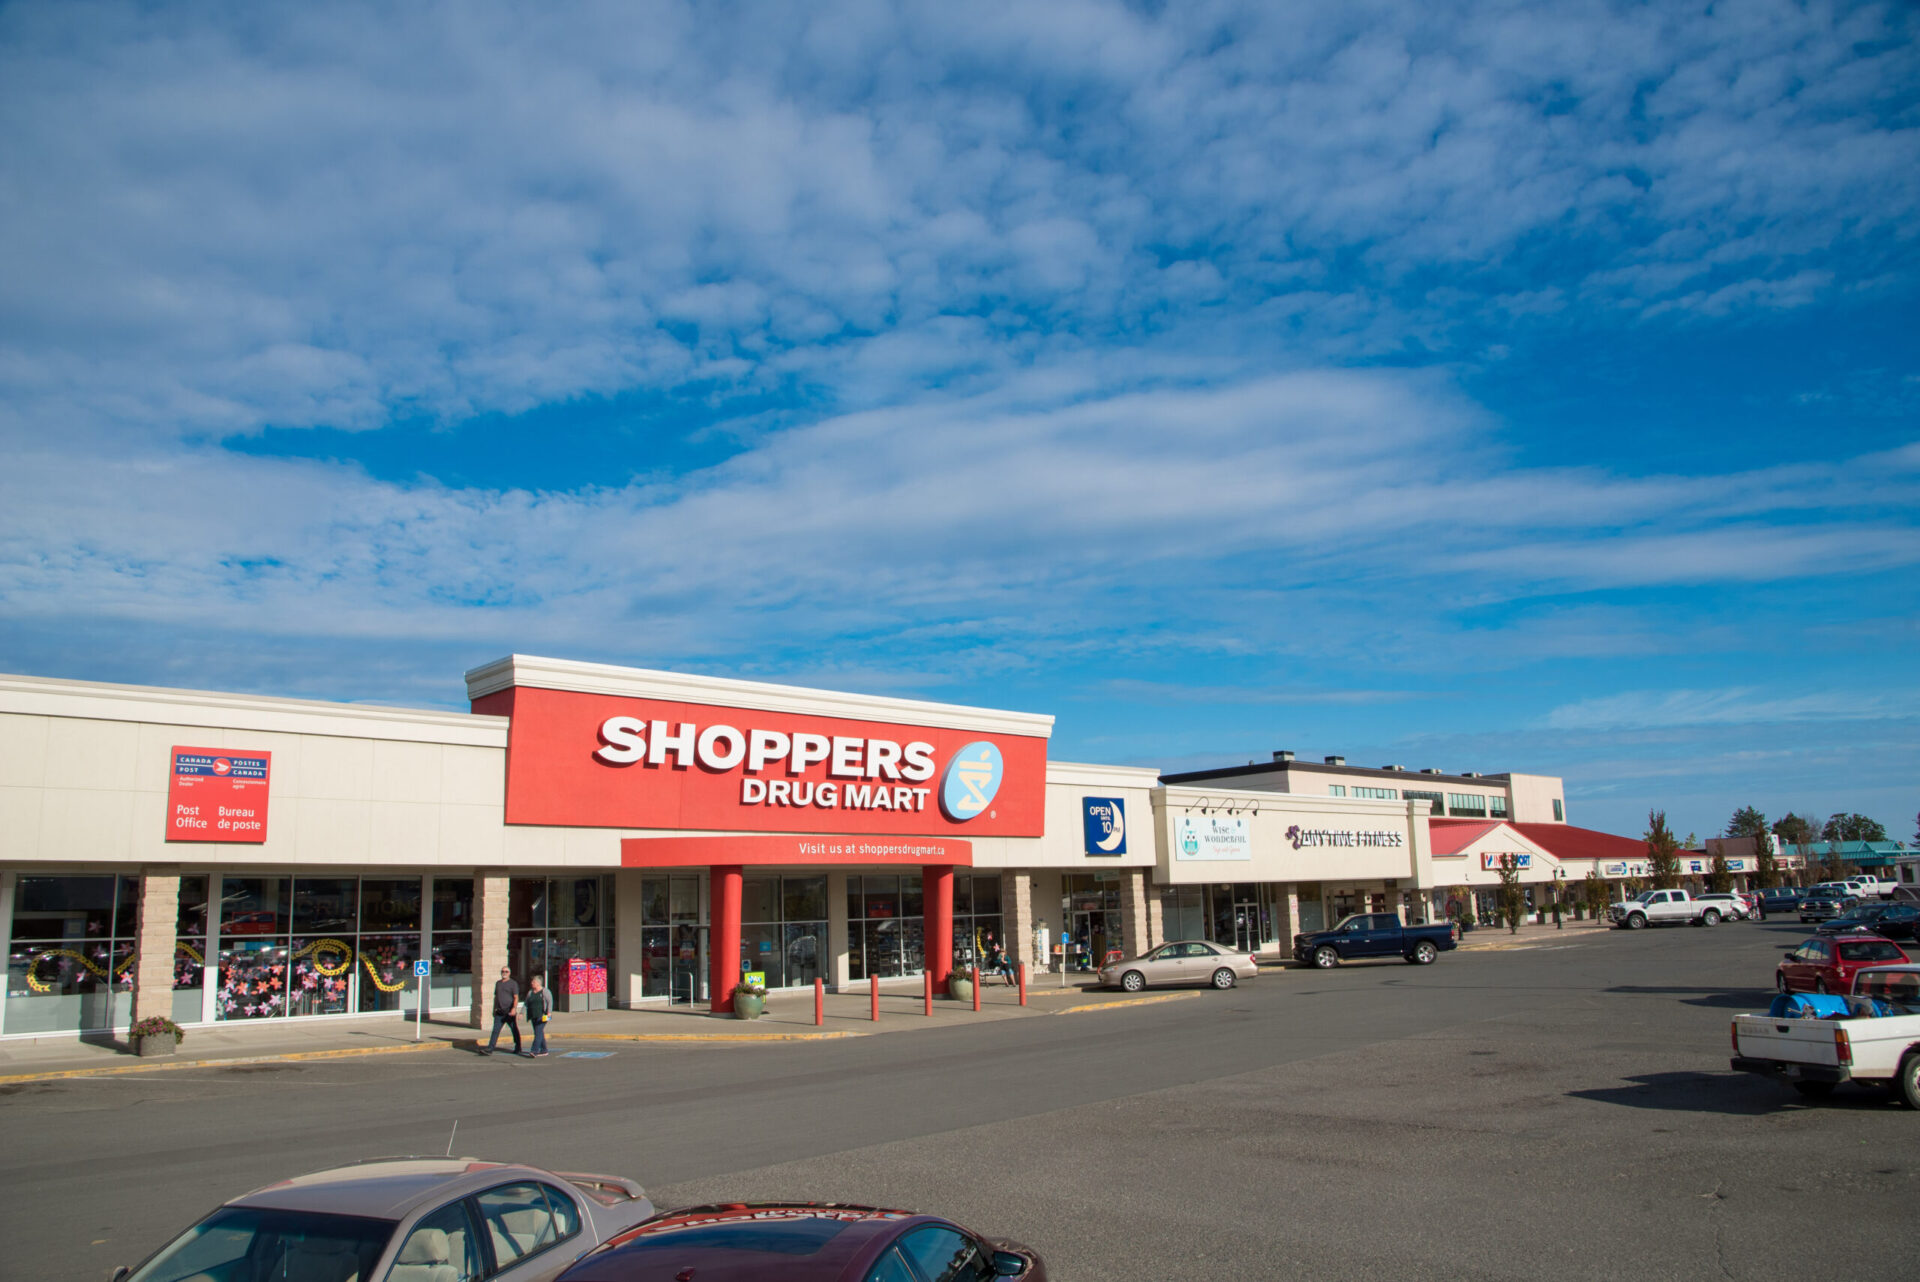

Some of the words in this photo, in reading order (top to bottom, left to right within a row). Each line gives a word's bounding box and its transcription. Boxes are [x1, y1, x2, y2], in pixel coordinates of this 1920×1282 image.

[597, 716, 936, 781] SHOPPERS
[743, 778, 838, 807] DRUG
[845, 784, 931, 811] MART
[177, 804, 200, 816] Post
[218, 806, 254, 817] Bureau
[1089, 806, 1112, 816] OPEN
[176, 817, 208, 828] Office
[218, 819, 231, 829] de
[232, 820, 261, 831] poste
[1102, 821, 1112, 834] 10
[1301, 830, 1354, 847] ANYTIME
[1356, 831, 1402, 847] FITNESS
[799, 842, 826, 854] Visit
[829, 845, 842, 854] us
[845, 843, 856, 854] at
[859, 843, 945, 856] shoppersdrugmart.ca
